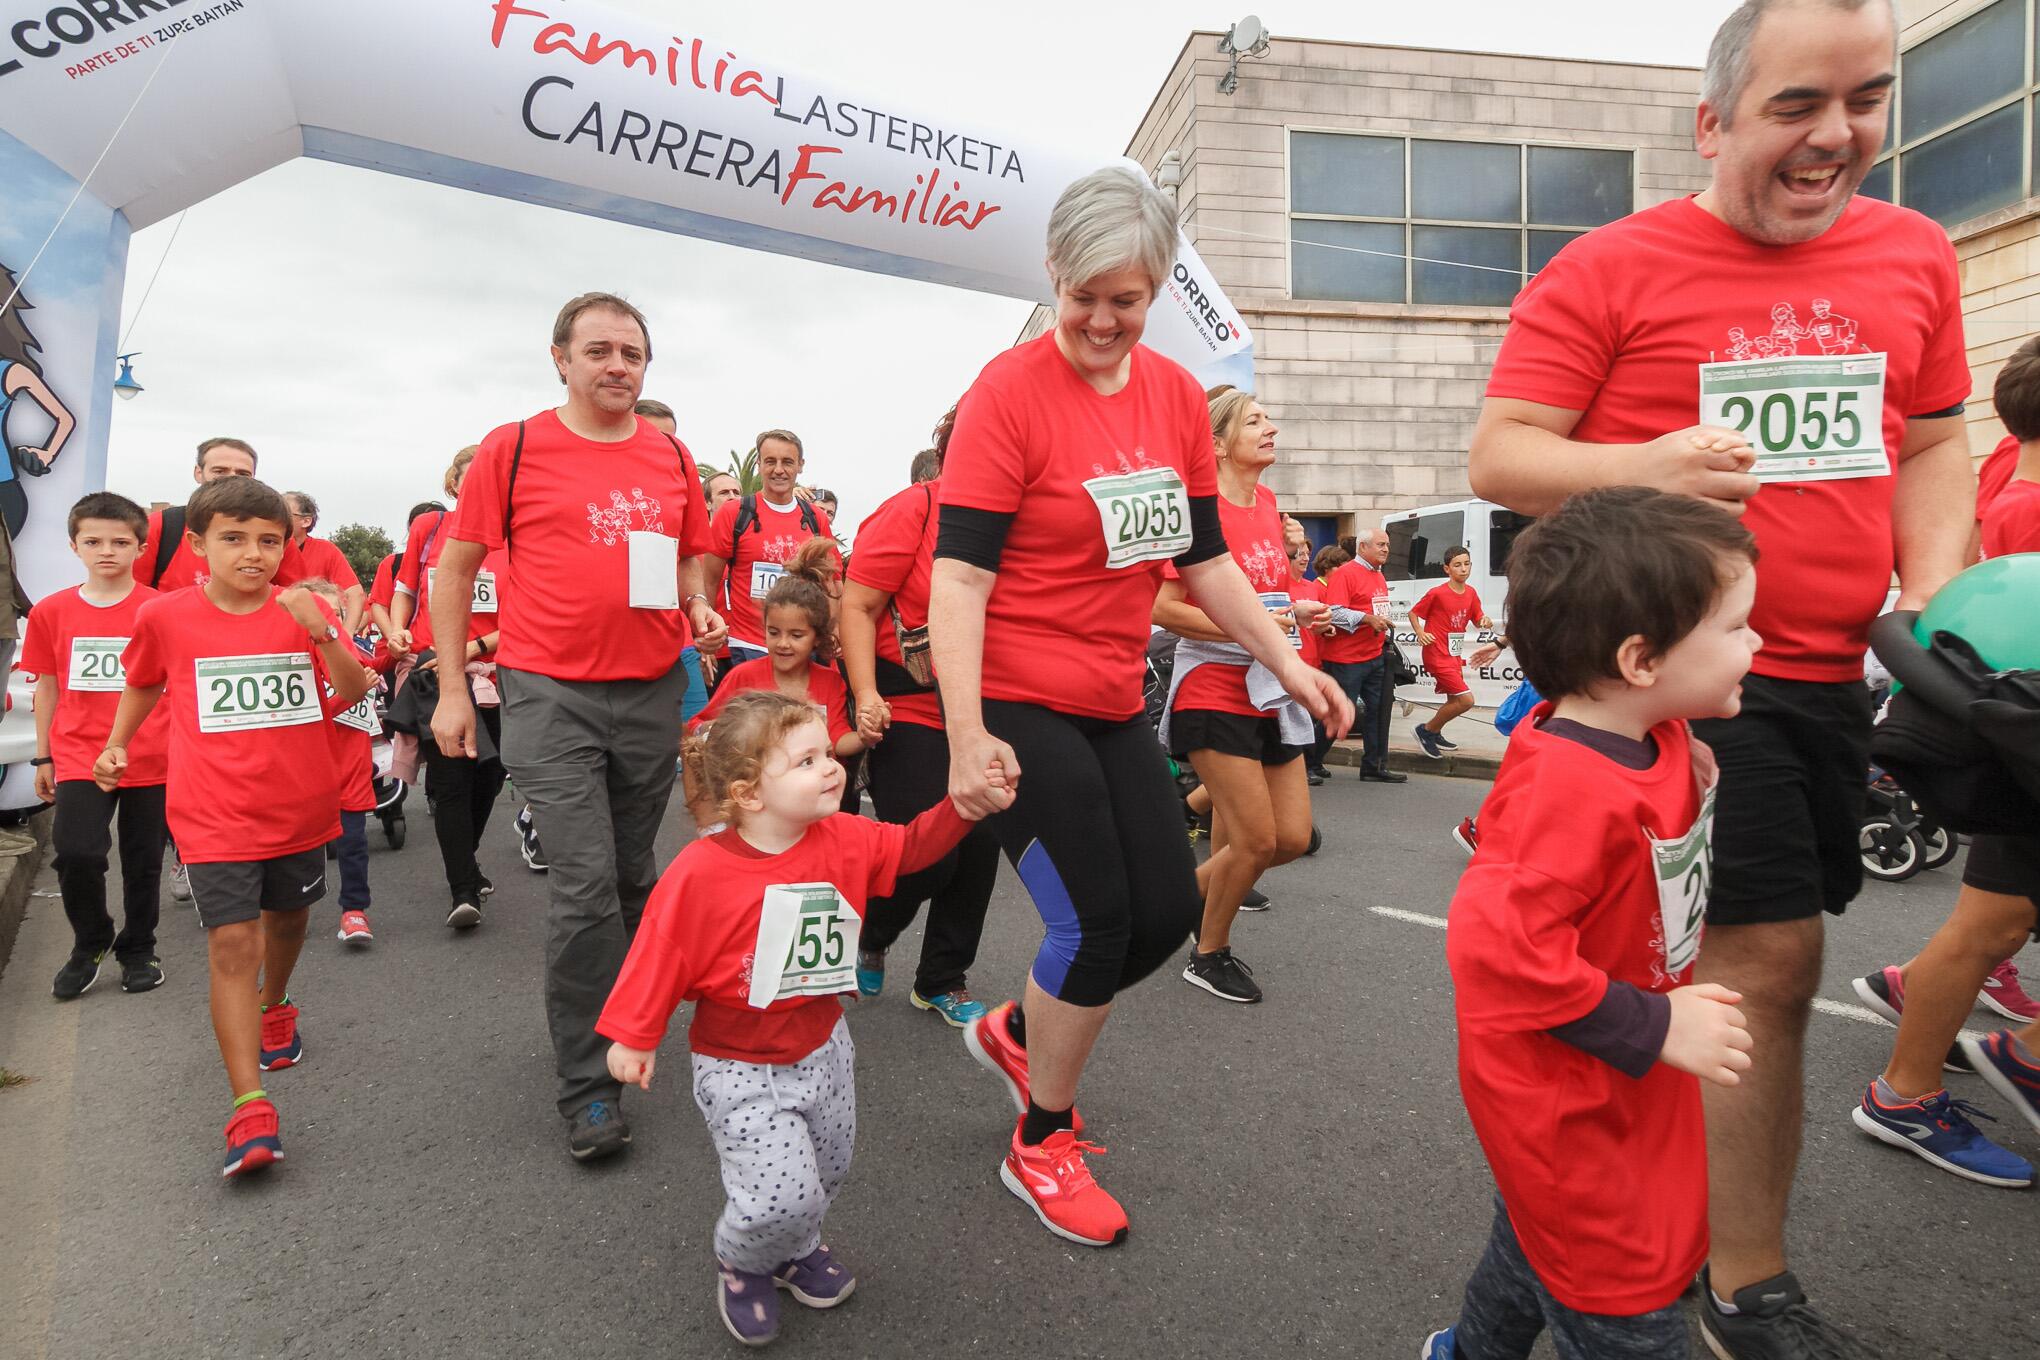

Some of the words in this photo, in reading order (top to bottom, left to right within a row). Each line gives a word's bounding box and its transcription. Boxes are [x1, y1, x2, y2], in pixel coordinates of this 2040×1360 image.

[11, 0, 191, 58] CORR
[65, 50, 118, 80] PARTE
[115, 41, 140, 59] DE
[136, 34, 154, 48] TI
[153, 21, 195, 42] ZURE
[193, 0, 244, 27] BAITAN
[522, 75, 780, 194] CARRERA
[781, 143, 1001, 230] Familiar
[774, 76, 1025, 183] LASTERKETA
[1173, 257, 1230, 342] ORREO
[1186, 309, 1200, 328] ZURE
[1198, 328, 1218, 352] BAITAN
[1721, 391, 1861, 452] 2055
[1111, 492, 1182, 543] 2055
[81, 653, 126, 678] 20
[211, 673, 306, 713] 2036
[1480, 667, 1500, 680] EL
[1502, 667, 1524, 681] CO
[783, 914, 845, 971] 55
